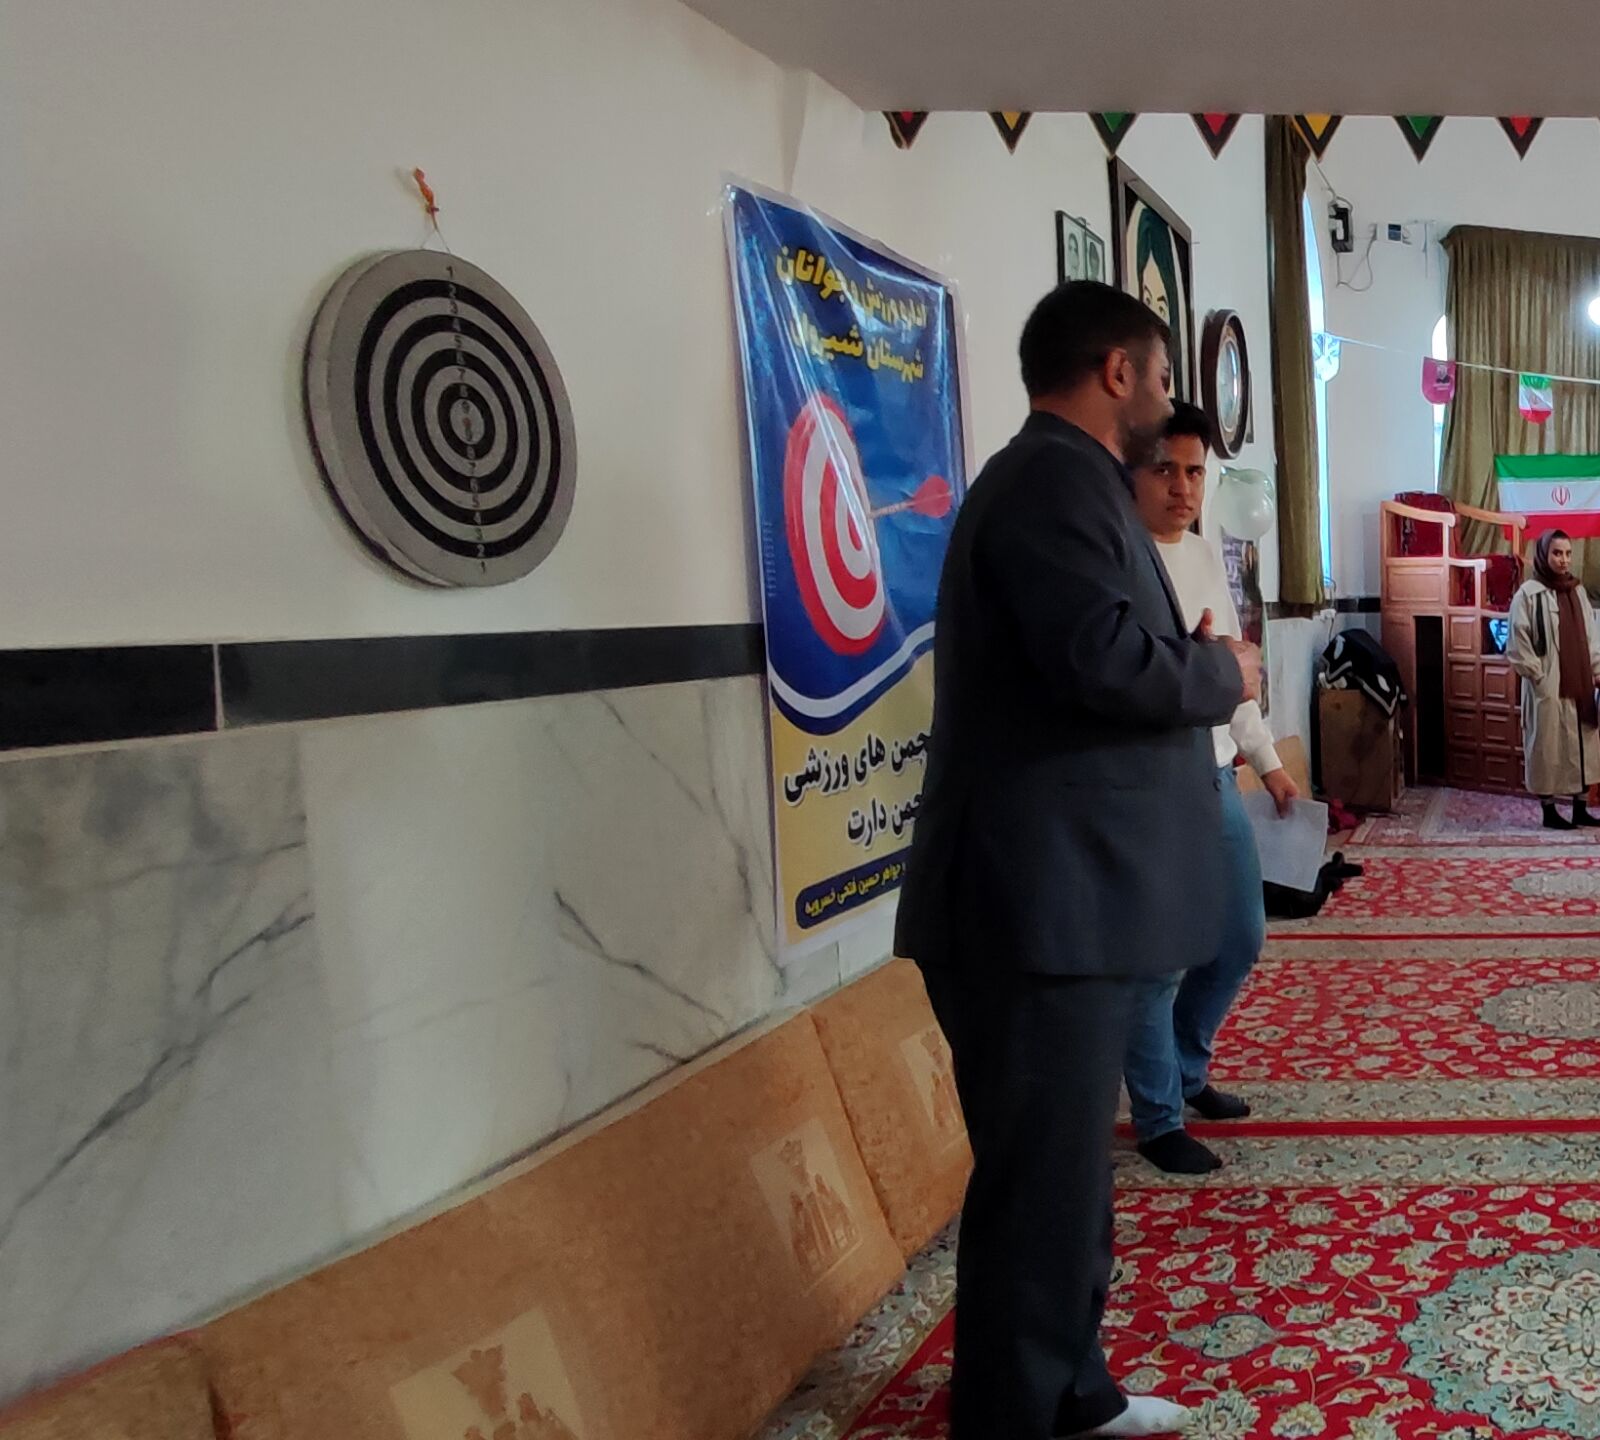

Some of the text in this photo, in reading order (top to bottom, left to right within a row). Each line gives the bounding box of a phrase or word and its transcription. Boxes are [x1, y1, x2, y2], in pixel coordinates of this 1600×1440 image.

[776, 245, 849, 303] جوانان
[866, 336, 924, 383] شهرستان
[784, 731, 932, 803] جمن های ورزشی
[847, 797, 887, 847] دارت
